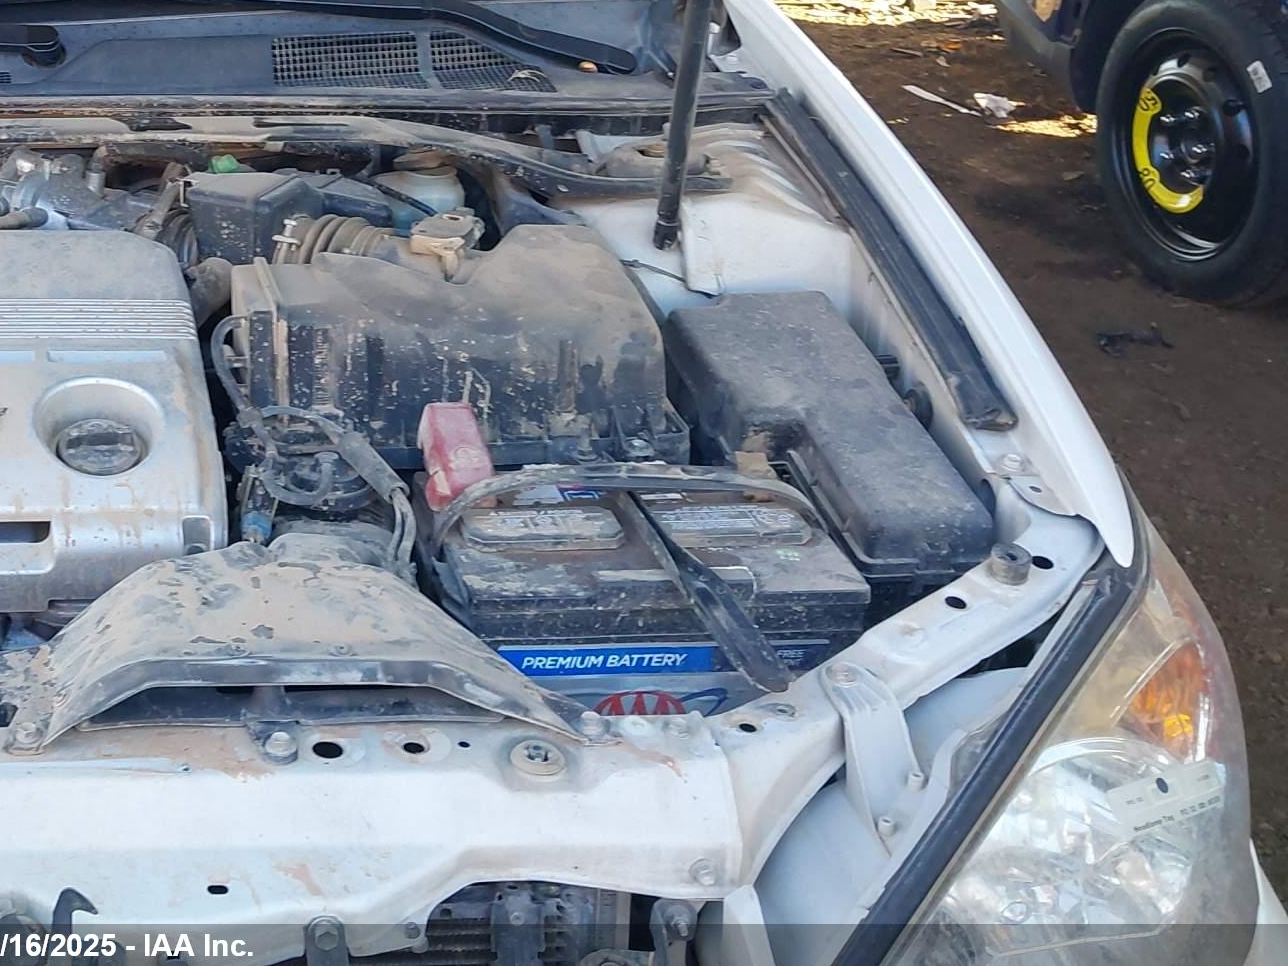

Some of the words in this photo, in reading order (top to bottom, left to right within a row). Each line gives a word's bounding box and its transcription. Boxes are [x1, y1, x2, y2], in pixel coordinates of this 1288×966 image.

[776, 649, 806, 658] FREE
[521, 655, 603, 670] PREMIUM
[605, 652, 688, 668] BATTERY
